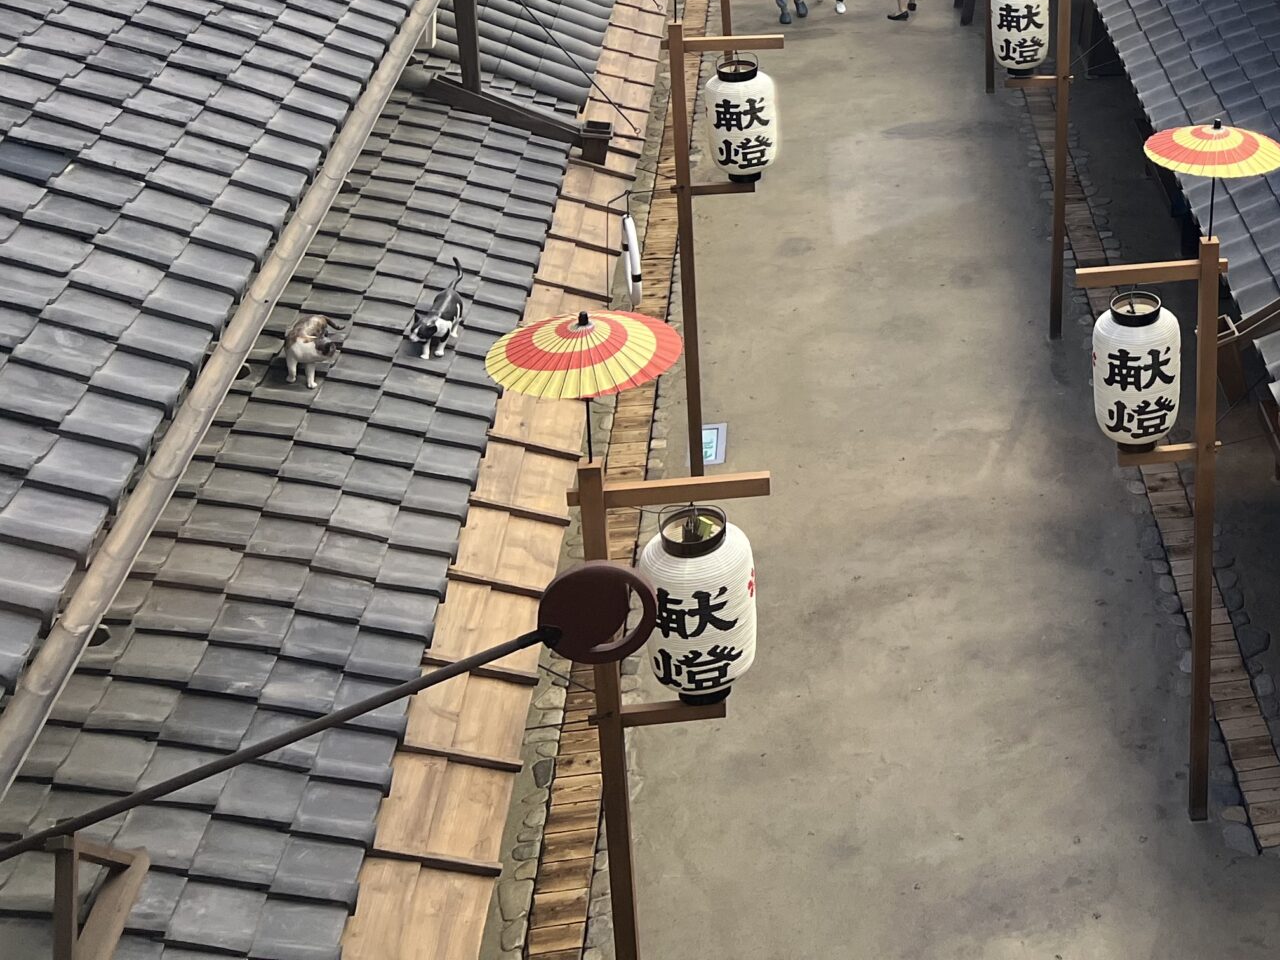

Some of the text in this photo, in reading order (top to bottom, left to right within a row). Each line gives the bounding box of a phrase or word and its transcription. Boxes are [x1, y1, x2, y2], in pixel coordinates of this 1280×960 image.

[997, 3, 1044, 65] 献燈
[713, 97, 773, 170] 献燈
[1104, 346, 1175, 438] 献燈
[653, 586, 743, 695] 献燈
